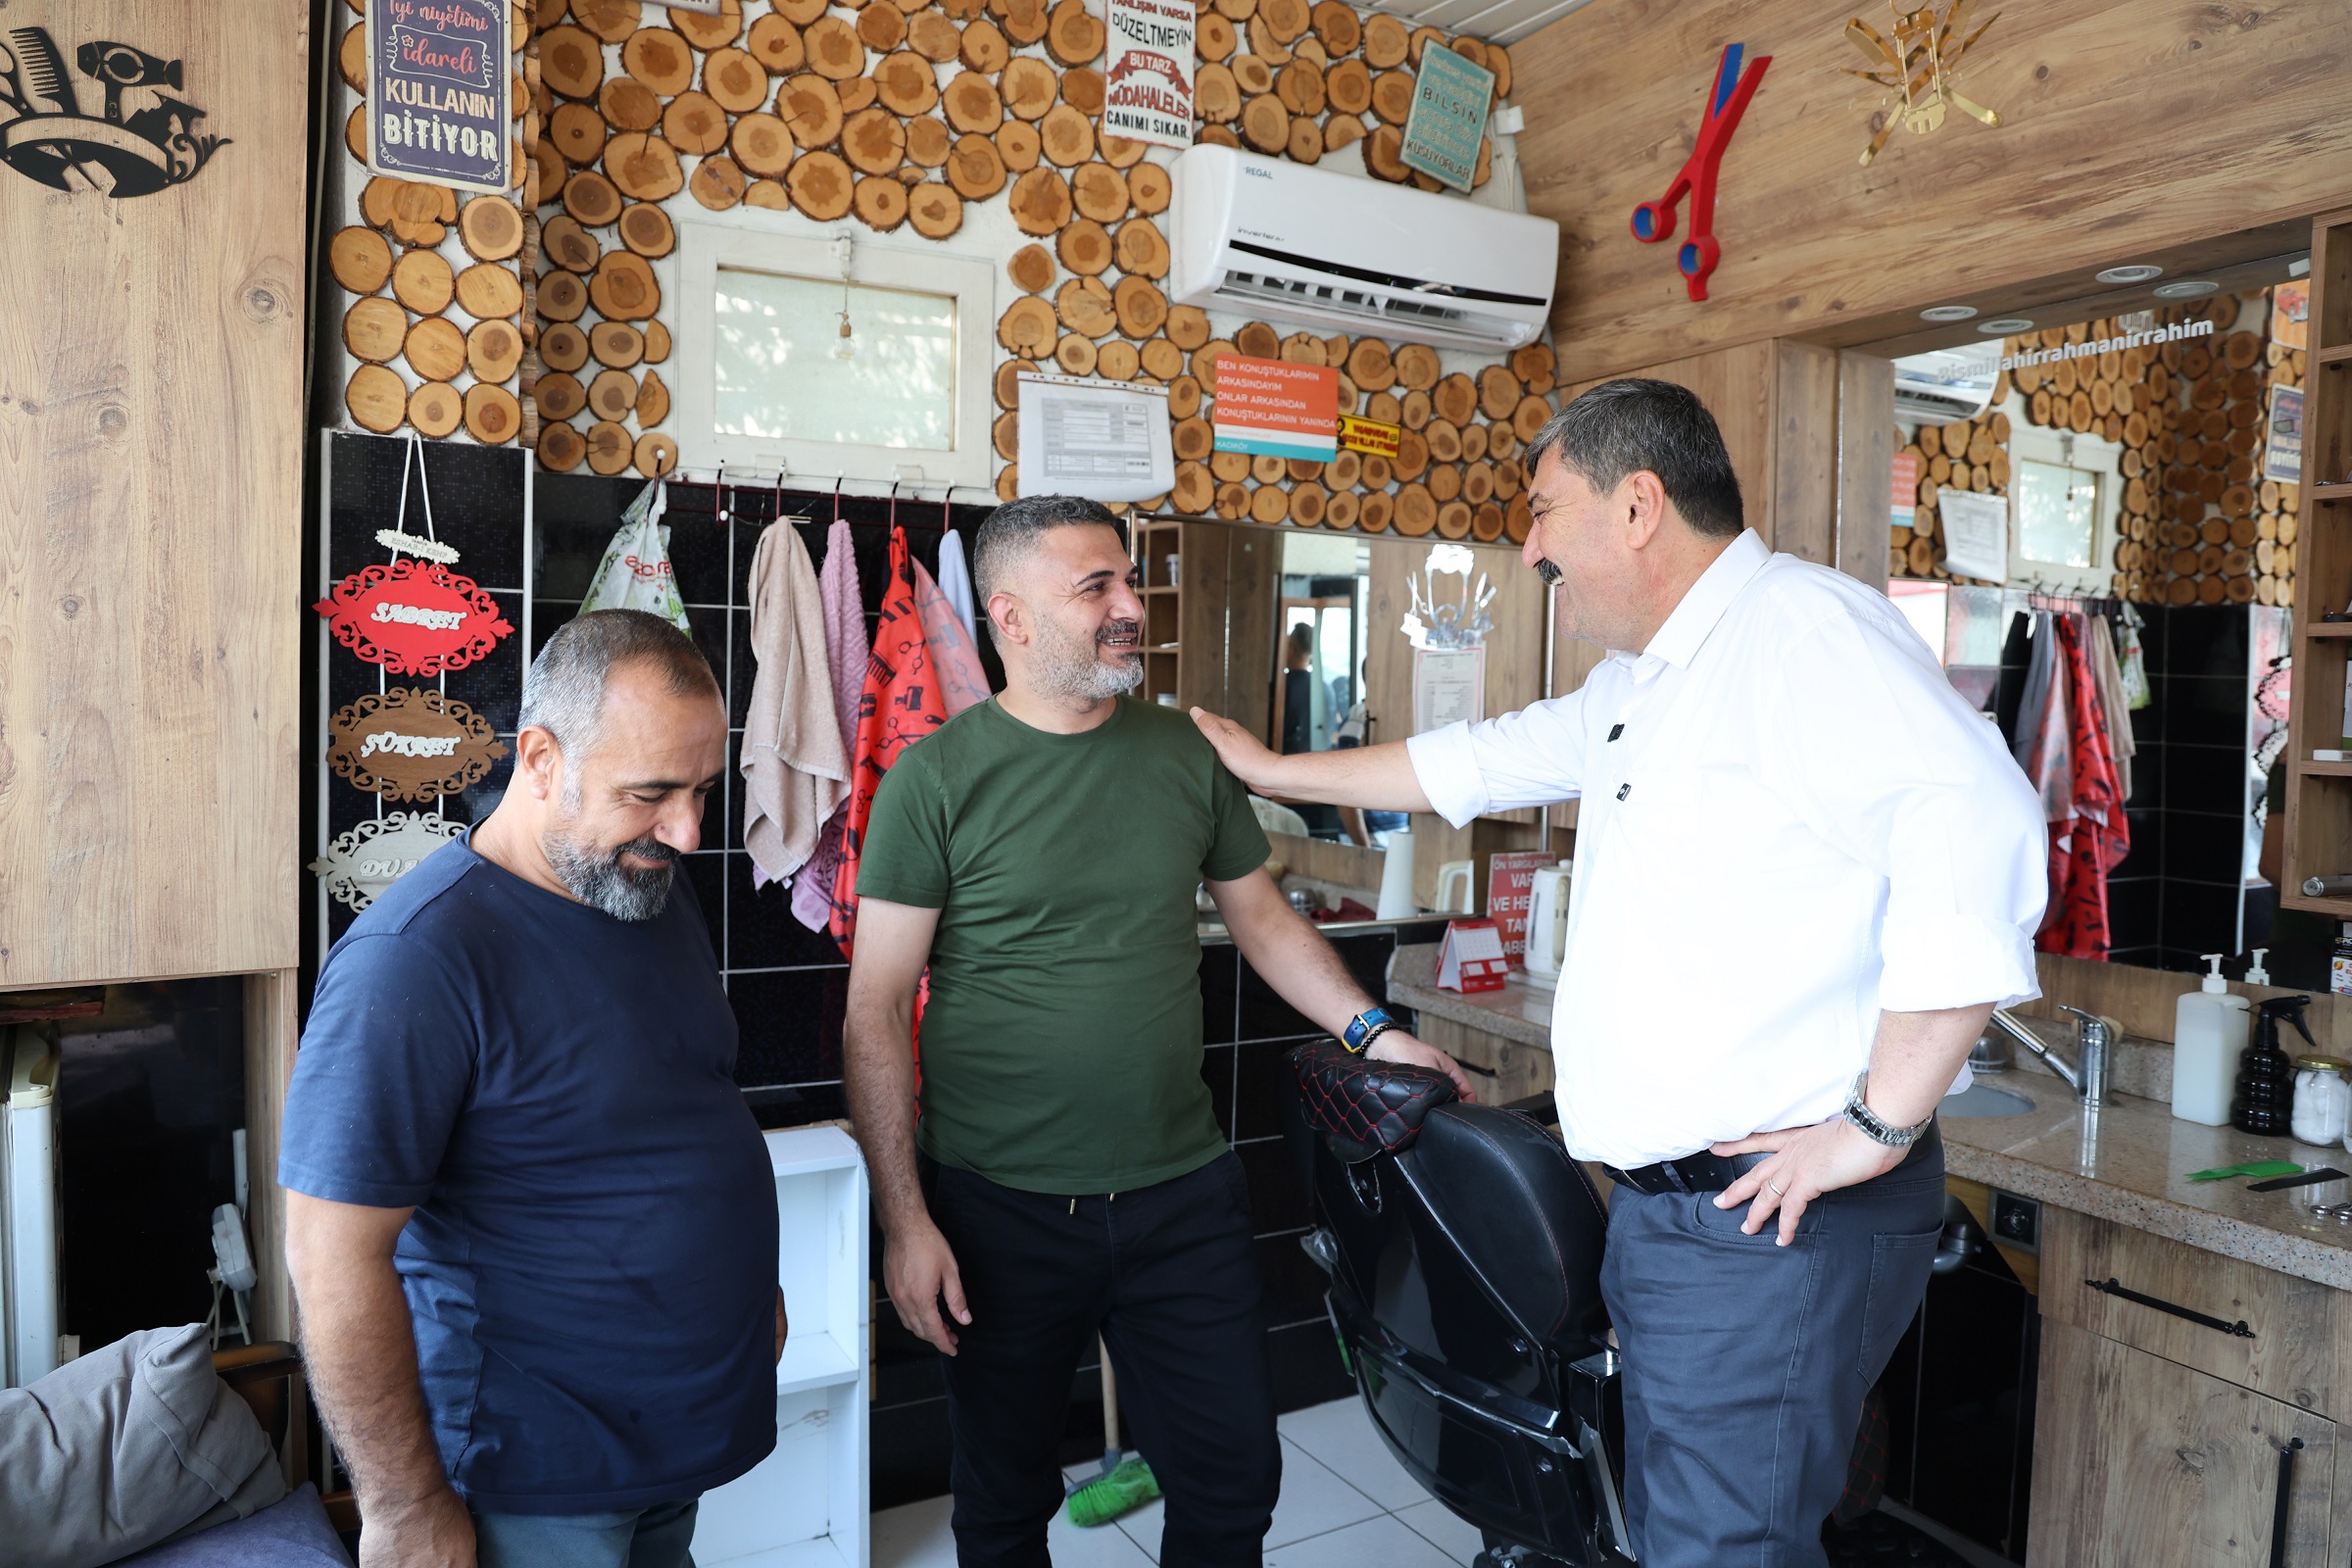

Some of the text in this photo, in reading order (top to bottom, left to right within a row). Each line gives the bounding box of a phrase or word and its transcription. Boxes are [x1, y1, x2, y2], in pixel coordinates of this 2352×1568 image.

[419, 5, 488, 31] niyetimi
[1159, 5, 1193, 23] VARSA
[1112, 13, 1192, 47] DÜZELTMEYİN
[403, 38, 477, 74] idareli
[1130, 52, 1172, 74] BU TARZ
[385, 76, 495, 121] KULLANIN
[1107, 83, 1191, 122] MÜDAHALELER
[1423, 85, 1479, 124] BİLSİN
[383, 109, 498, 162] BİTİYOR
[1106, 110, 1191, 140] CANIMI SIKAR.
[1245, 166, 1273, 179] REGAL
[1216, 359, 1237, 371] BEN
[1216, 375, 1283, 392] ARKASINDAYIM
[1216, 390, 1306, 410] ONLAR ARKASINDAN
[1216, 407, 1336, 428] KONUŞTUKLARININ YANINDA
[1493, 897, 1510, 911] VE
